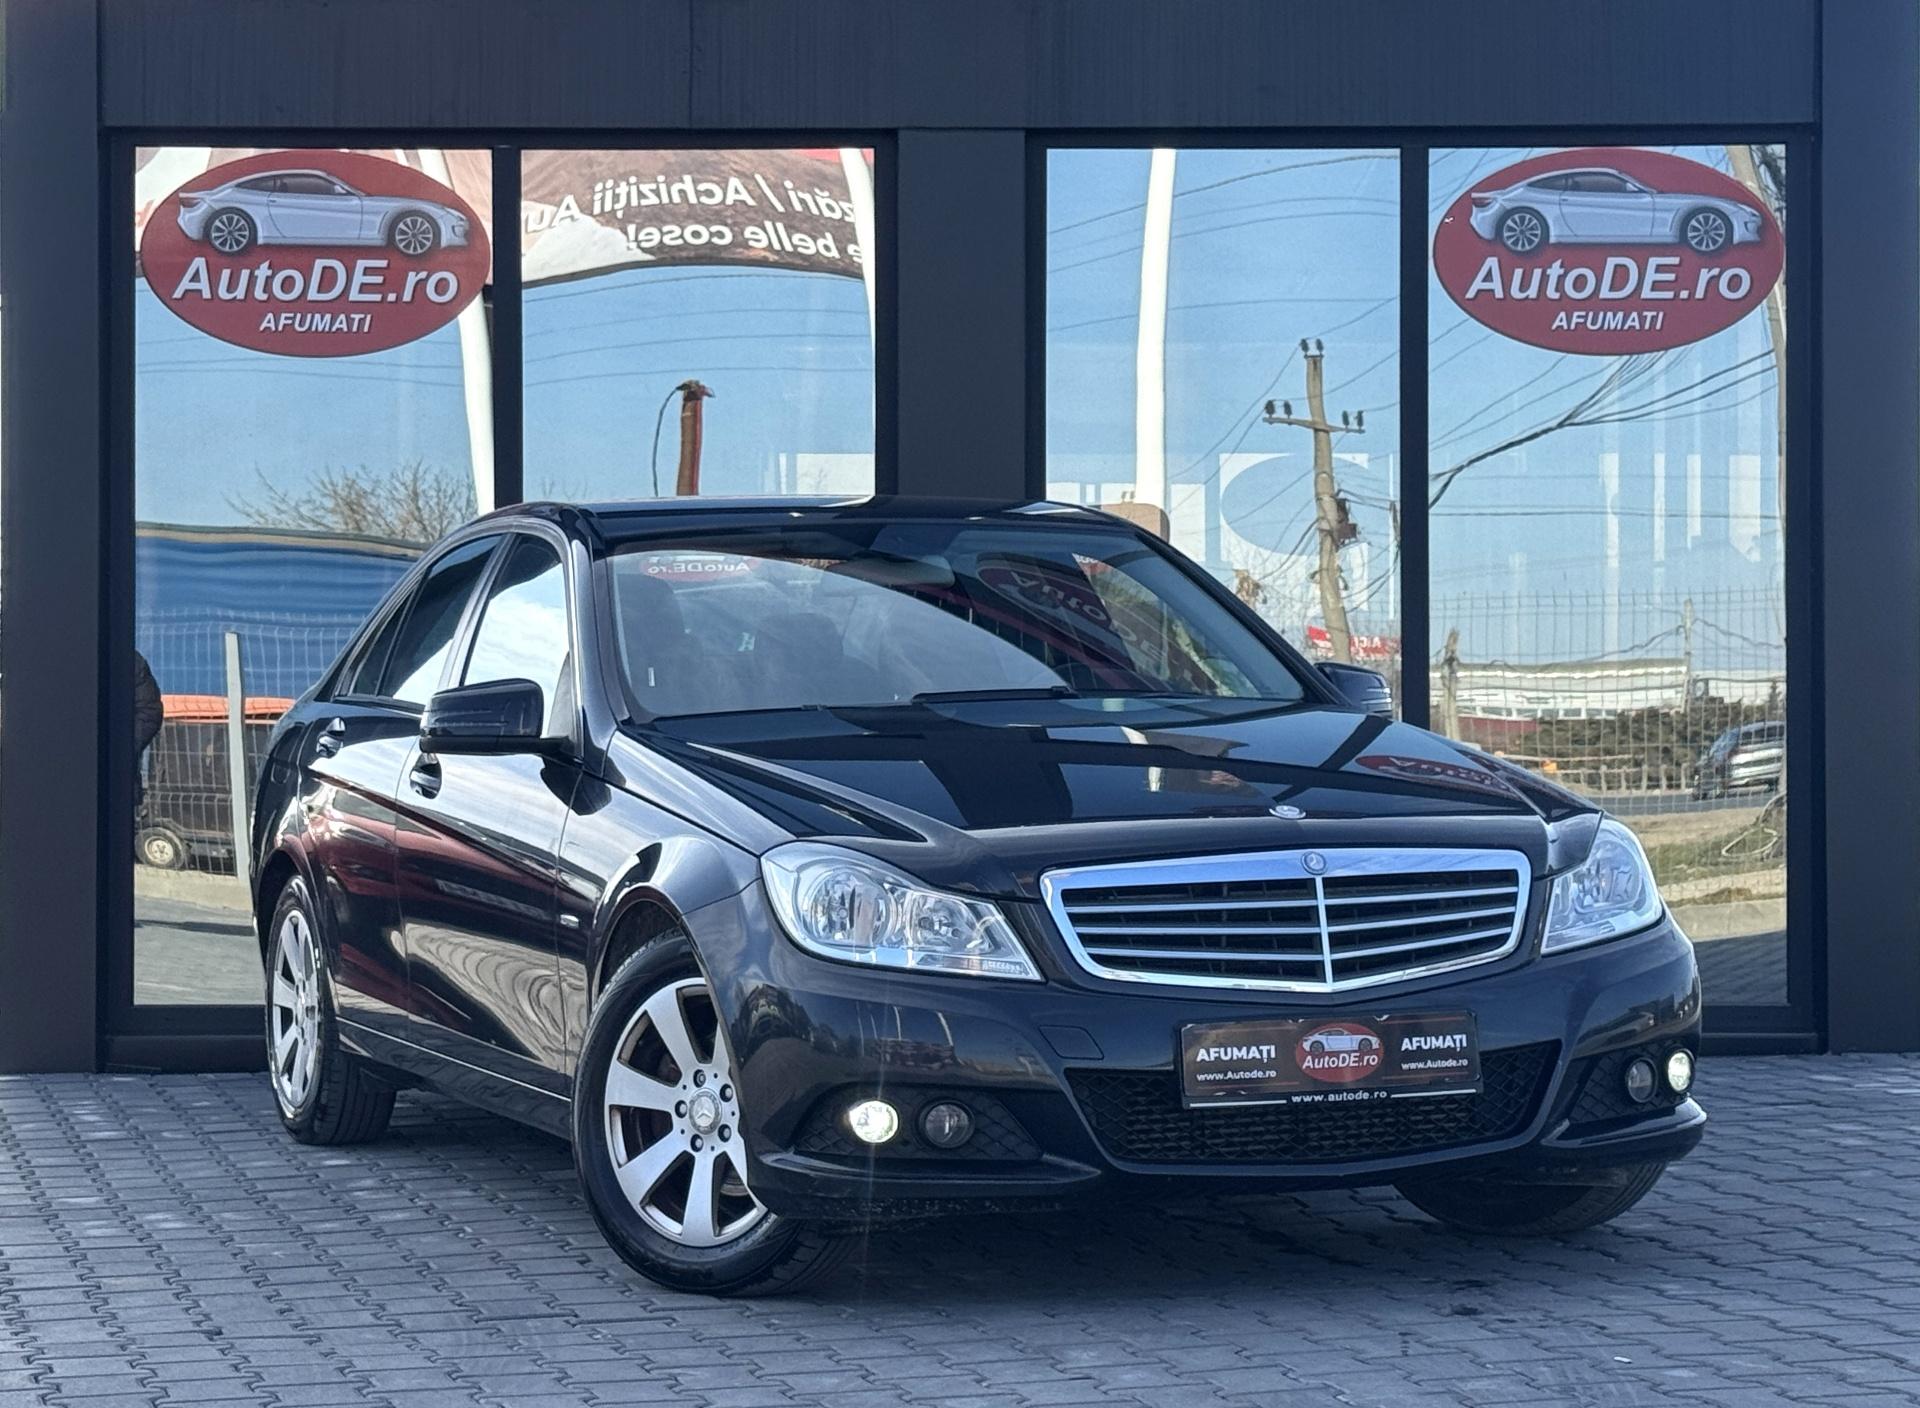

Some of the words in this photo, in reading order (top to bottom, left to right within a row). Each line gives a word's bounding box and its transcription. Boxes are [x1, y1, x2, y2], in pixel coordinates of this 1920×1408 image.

[172, 256, 459, 303] AutoDE.ro
[1465, 256, 1752, 301] AutoDE.ro
[259, 313, 372, 333] AFUMATI
[1551, 311, 1664, 331] AFUMATI
[1401, 1034, 1467, 1052] AFUMAȚI
[1196, 1045, 1276, 1063] AFUMAȚI
[1302, 1052, 1379, 1070] AutoDE.ro
[1196, 1069, 1277, 1081] www.Autode.ro
[1291, 1089, 1388, 1103] www.autode.ro
